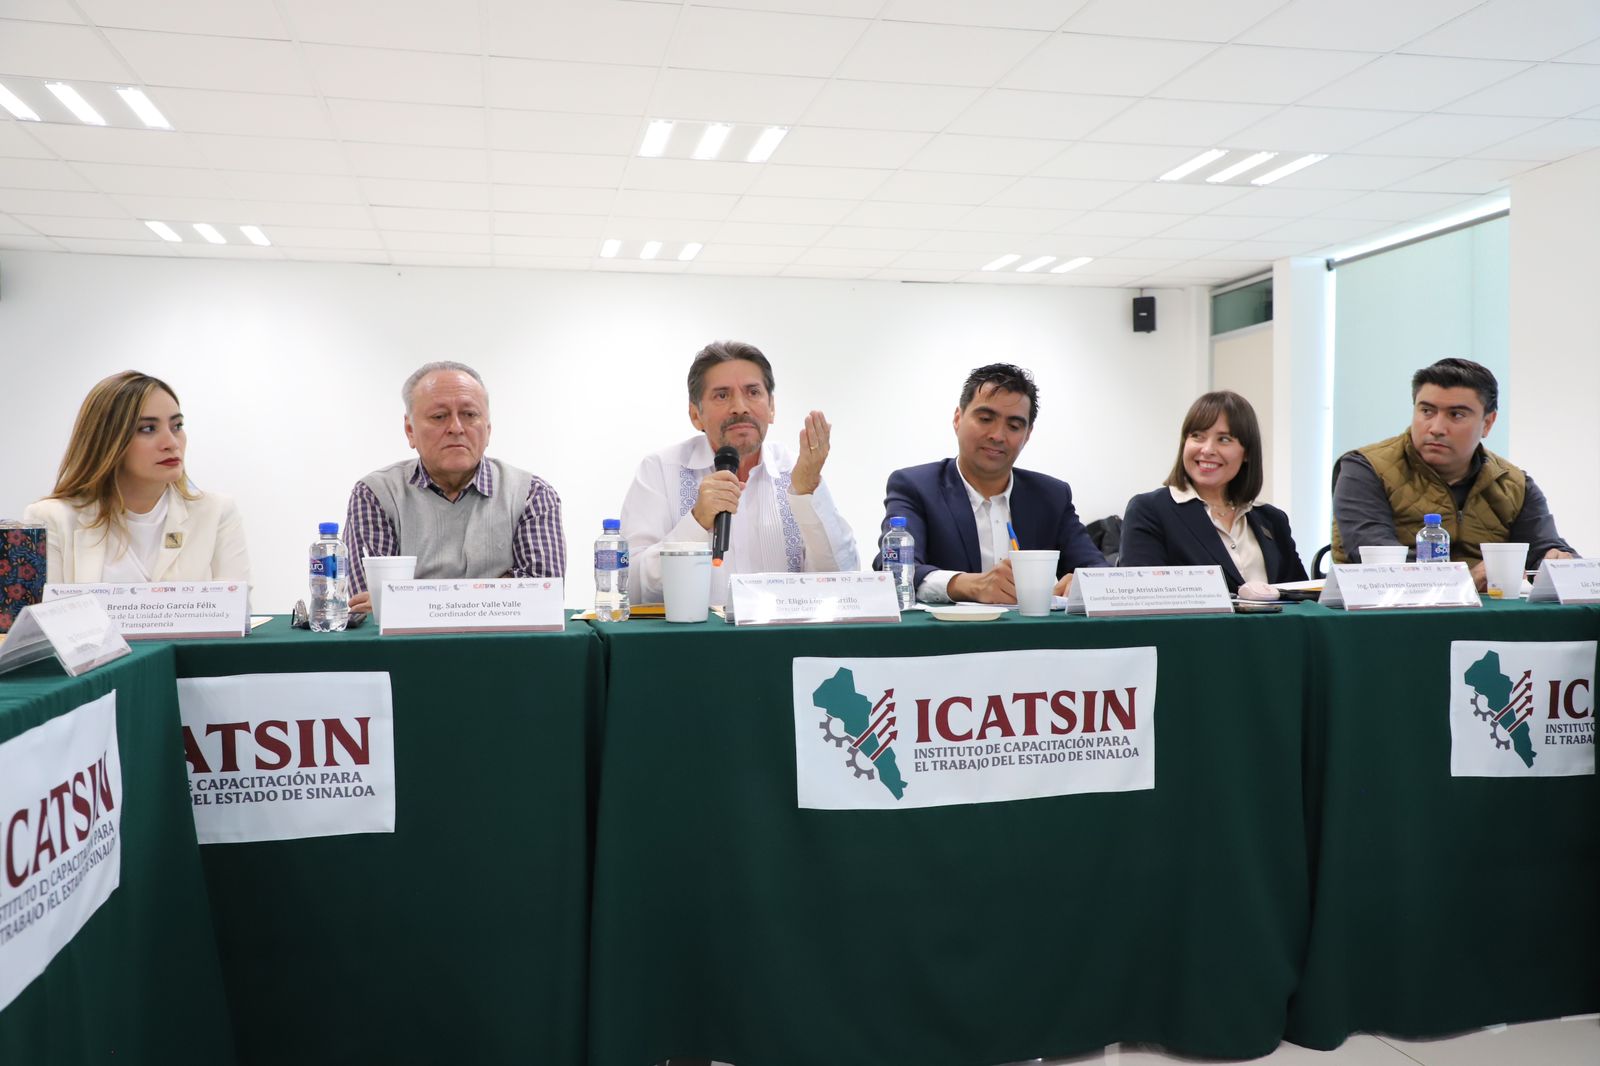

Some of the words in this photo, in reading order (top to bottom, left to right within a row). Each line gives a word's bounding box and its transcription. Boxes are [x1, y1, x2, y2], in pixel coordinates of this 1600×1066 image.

[121, 621, 174, 629] Transparencia
[1548, 678, 1595, 720] IC
[915, 686, 1138, 743] ICATSIN
[914, 746, 984, 760] INSTITUTO
[985, 744, 1000, 755] DE
[1003, 736, 1094, 753] CAPACITACIÓN
[1096, 735, 1130, 747] PARA
[1545, 736, 1557, 744] EL
[1560, 734, 1594, 745] TRABA
[914, 762, 929, 772] EL
[931, 759, 989, 771] TRABAJO
[992, 755, 1015, 767] DEL
[1019, 752, 1066, 765] ESTADO
[1068, 750, 1083, 761] DE
[1086, 748, 1139, 761] SINALOA
[196, 771, 316, 791] CAPACITACIÓN
[320, 771, 362, 784] PARA
[216, 790, 278, 804] ESTADO
[282, 788, 303, 800] DE
[309, 785, 375, 799] SINALOA
[0, 750, 114, 888] CATSIN
